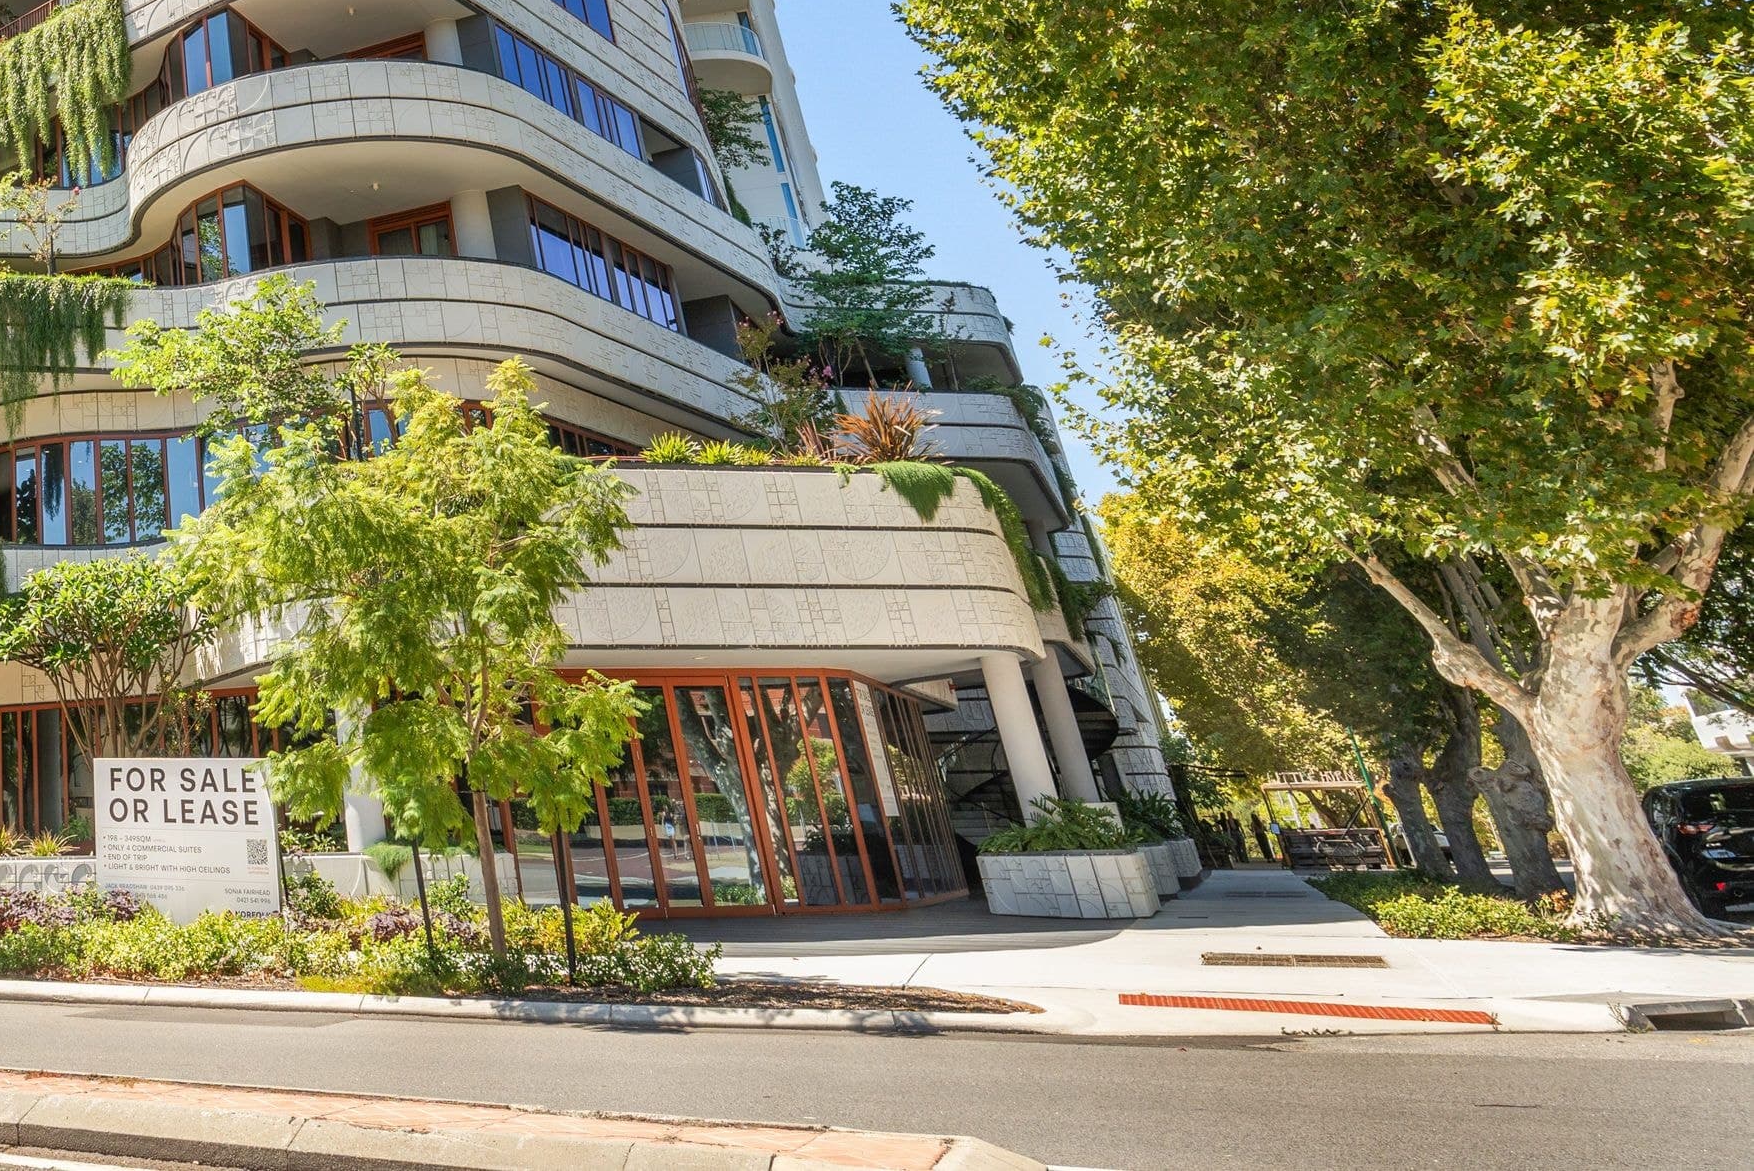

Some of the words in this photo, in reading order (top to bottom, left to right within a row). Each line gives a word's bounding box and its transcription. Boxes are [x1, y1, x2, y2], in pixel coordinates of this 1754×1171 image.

[110, 767, 166, 792] FOR
[180, 768, 256, 793] SALE
[109, 798, 149, 823] OR
[164, 799, 259, 825] LEASE
[131, 844, 177, 853] COMMERCIAL
[178, 845, 202, 854] SUITES
[134, 863, 159, 871] BRIGHT
[179, 865, 197, 873] HIGH
[198, 866, 230, 874] CEILINGS
